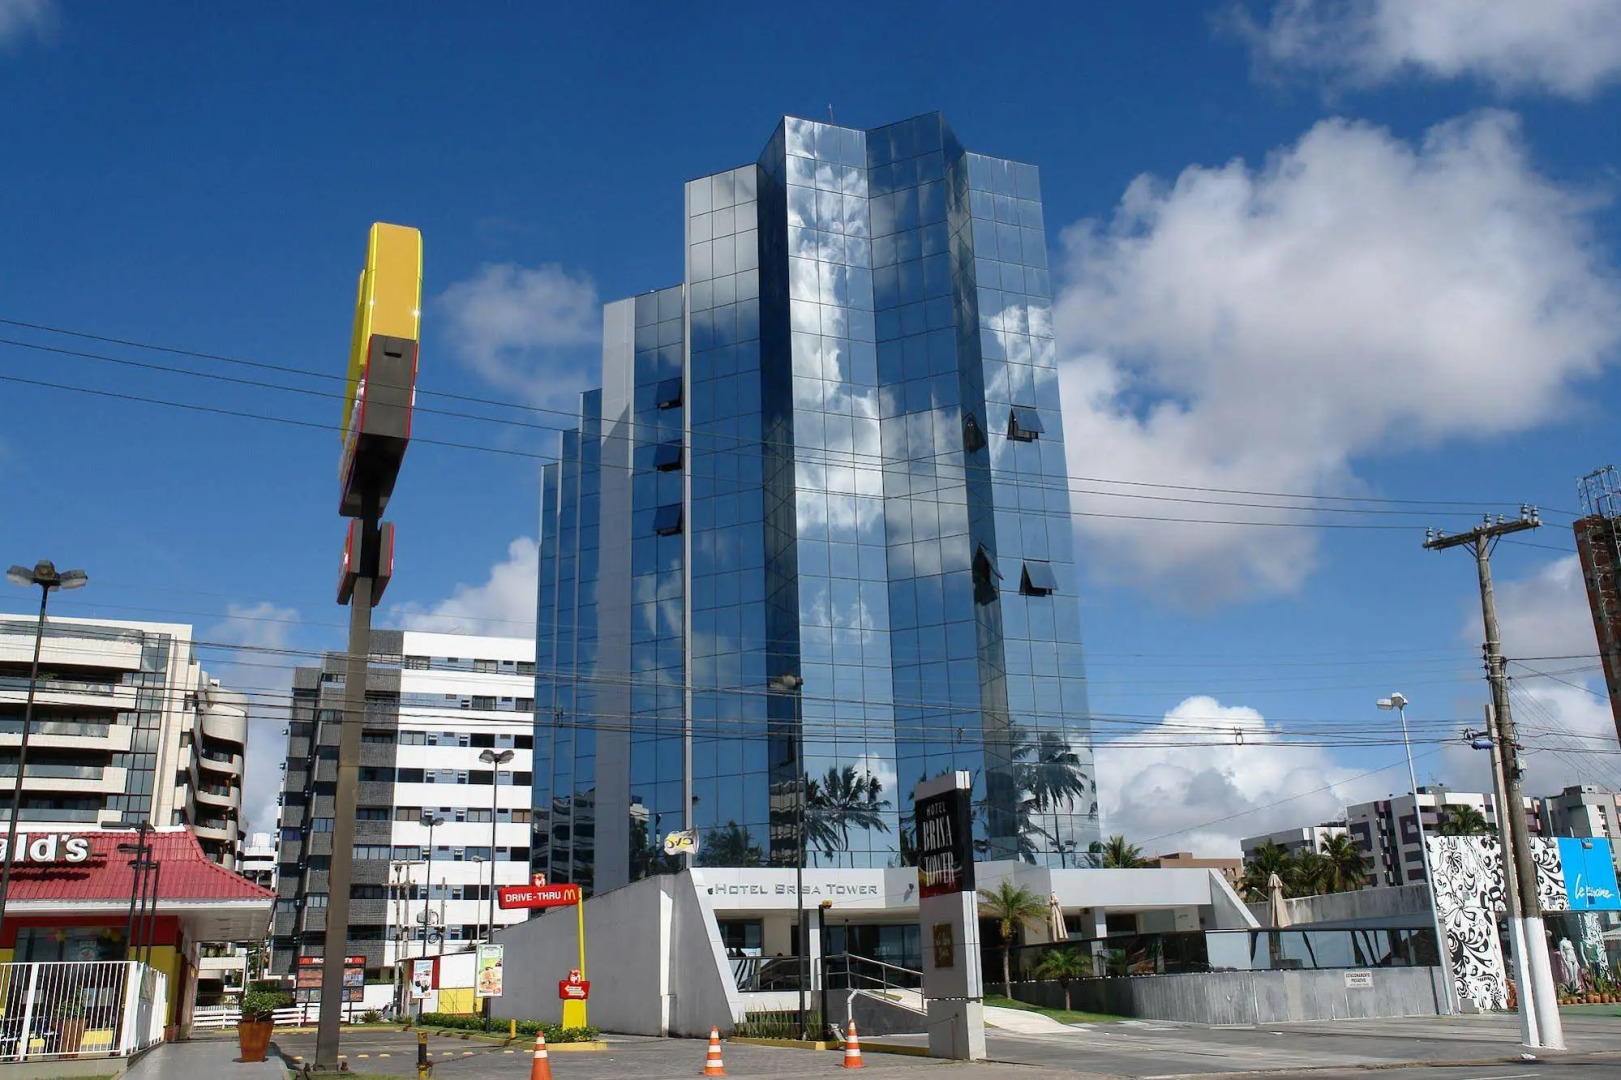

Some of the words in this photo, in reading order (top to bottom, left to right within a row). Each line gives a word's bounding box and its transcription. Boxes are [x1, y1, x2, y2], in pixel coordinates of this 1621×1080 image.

[926, 801, 946, 817] HOTEL
[922, 815, 953, 852] BRISA
[924, 852, 956, 888] TOWER
[775, 884, 821, 895] BRSA
